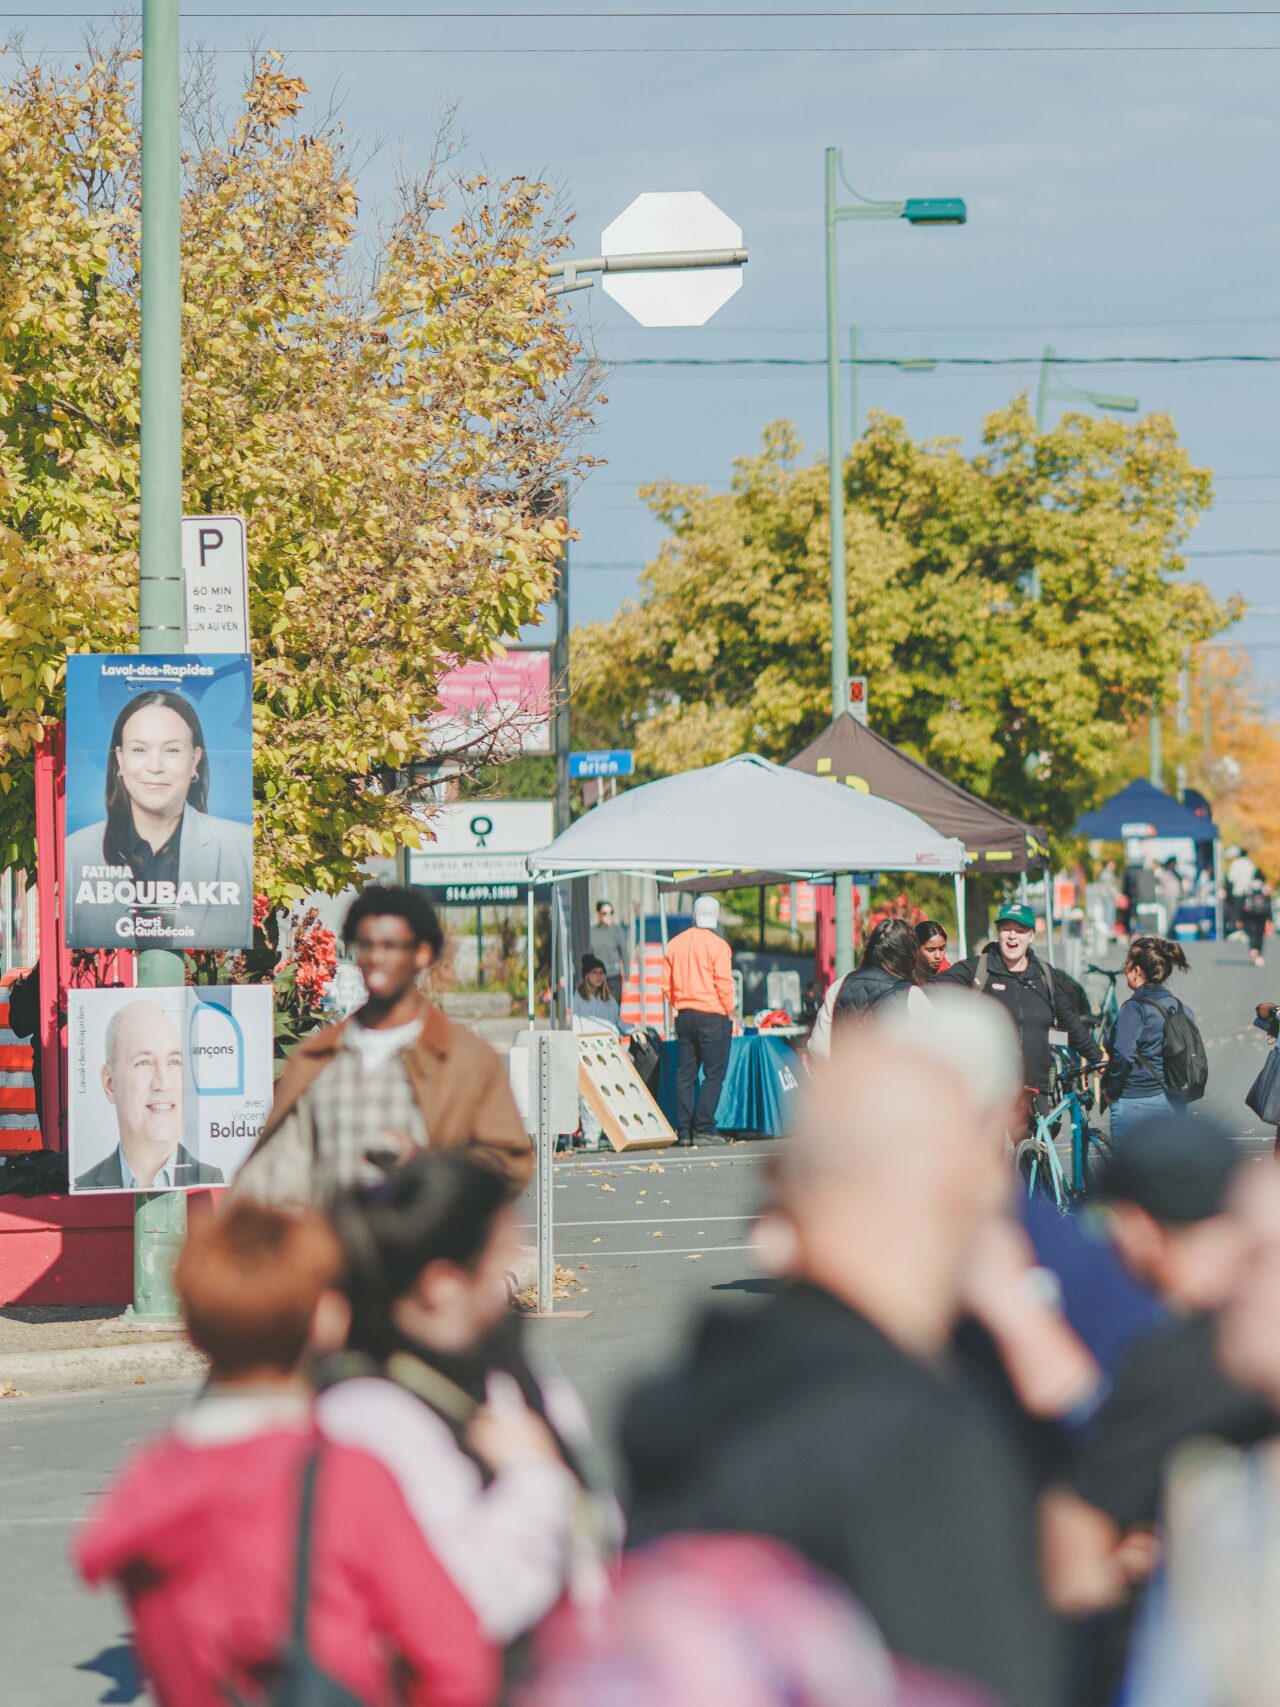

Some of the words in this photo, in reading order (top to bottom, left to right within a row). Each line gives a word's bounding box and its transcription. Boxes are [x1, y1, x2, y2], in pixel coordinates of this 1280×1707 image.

[198, 528, 224, 567] P
[193, 586, 207, 595] 60
[211, 586, 231, 595] MIN
[193, 604, 206, 613] 9h
[216, 604, 232, 613] 21h
[208, 622, 219, 630] AU
[221, 621, 238, 630] VEN
[101, 664, 214, 677] Laval-des-Rapides
[81, 865, 134, 879] FATIMA
[75, 880, 241, 905] ABOUBAKR
[136, 916, 161, 927] Parti
[135, 926, 195, 937] Québécois
[231, 1110, 266, 1120] Vincent
